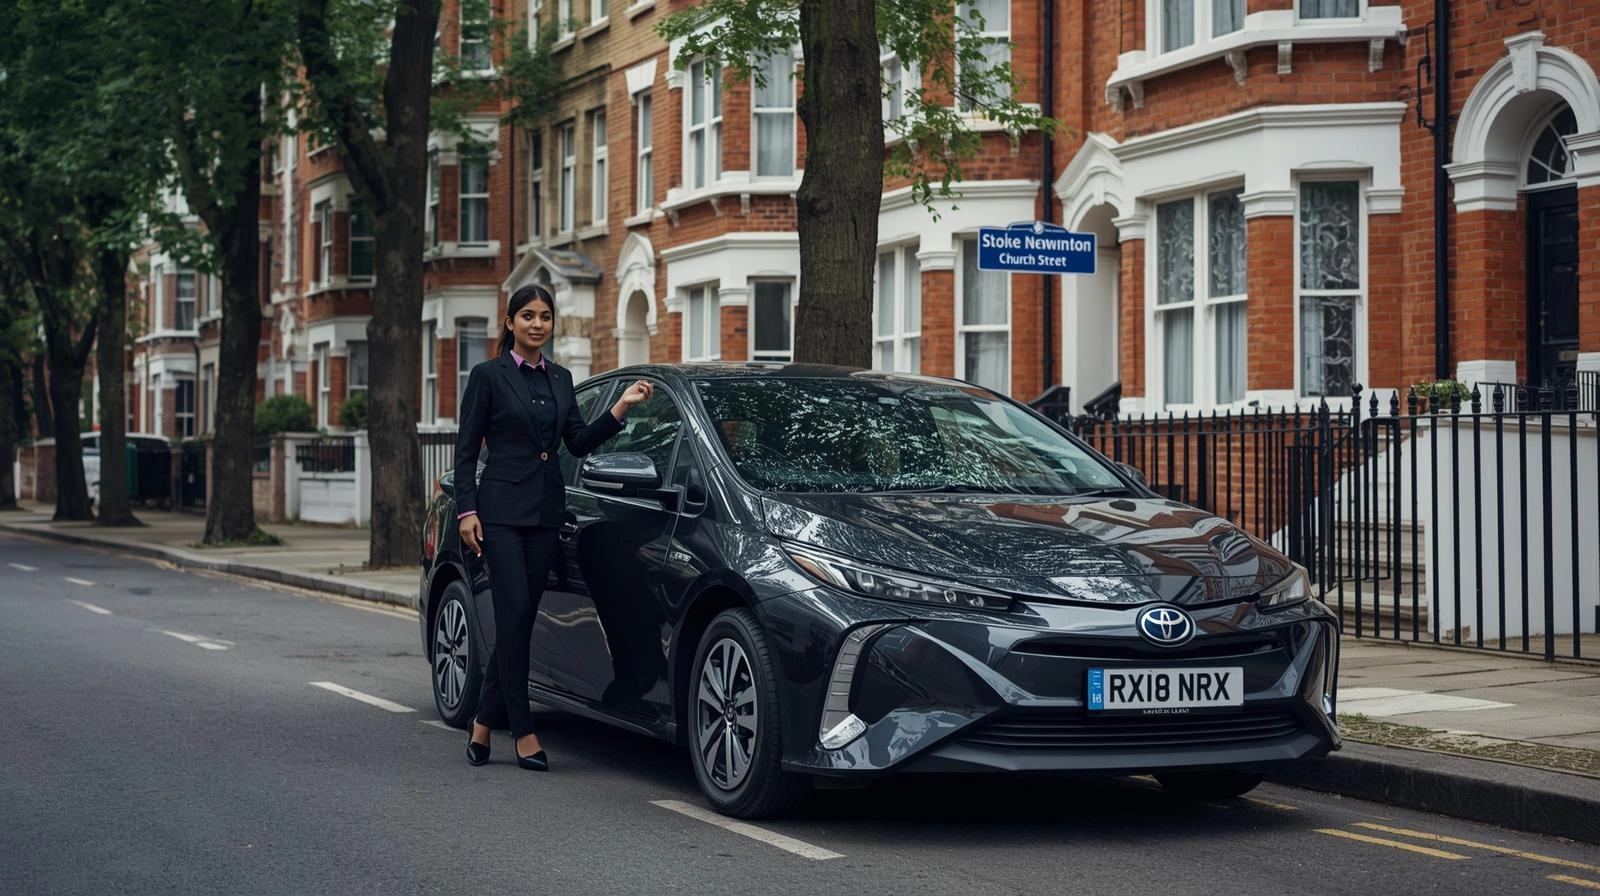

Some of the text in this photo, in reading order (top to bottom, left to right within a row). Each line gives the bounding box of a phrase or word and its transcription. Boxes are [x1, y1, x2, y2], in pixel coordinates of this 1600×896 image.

[982, 233, 1021, 249] Stoke
[999, 252, 1035, 265] Church
[1178, 672, 1231, 702] NRX
